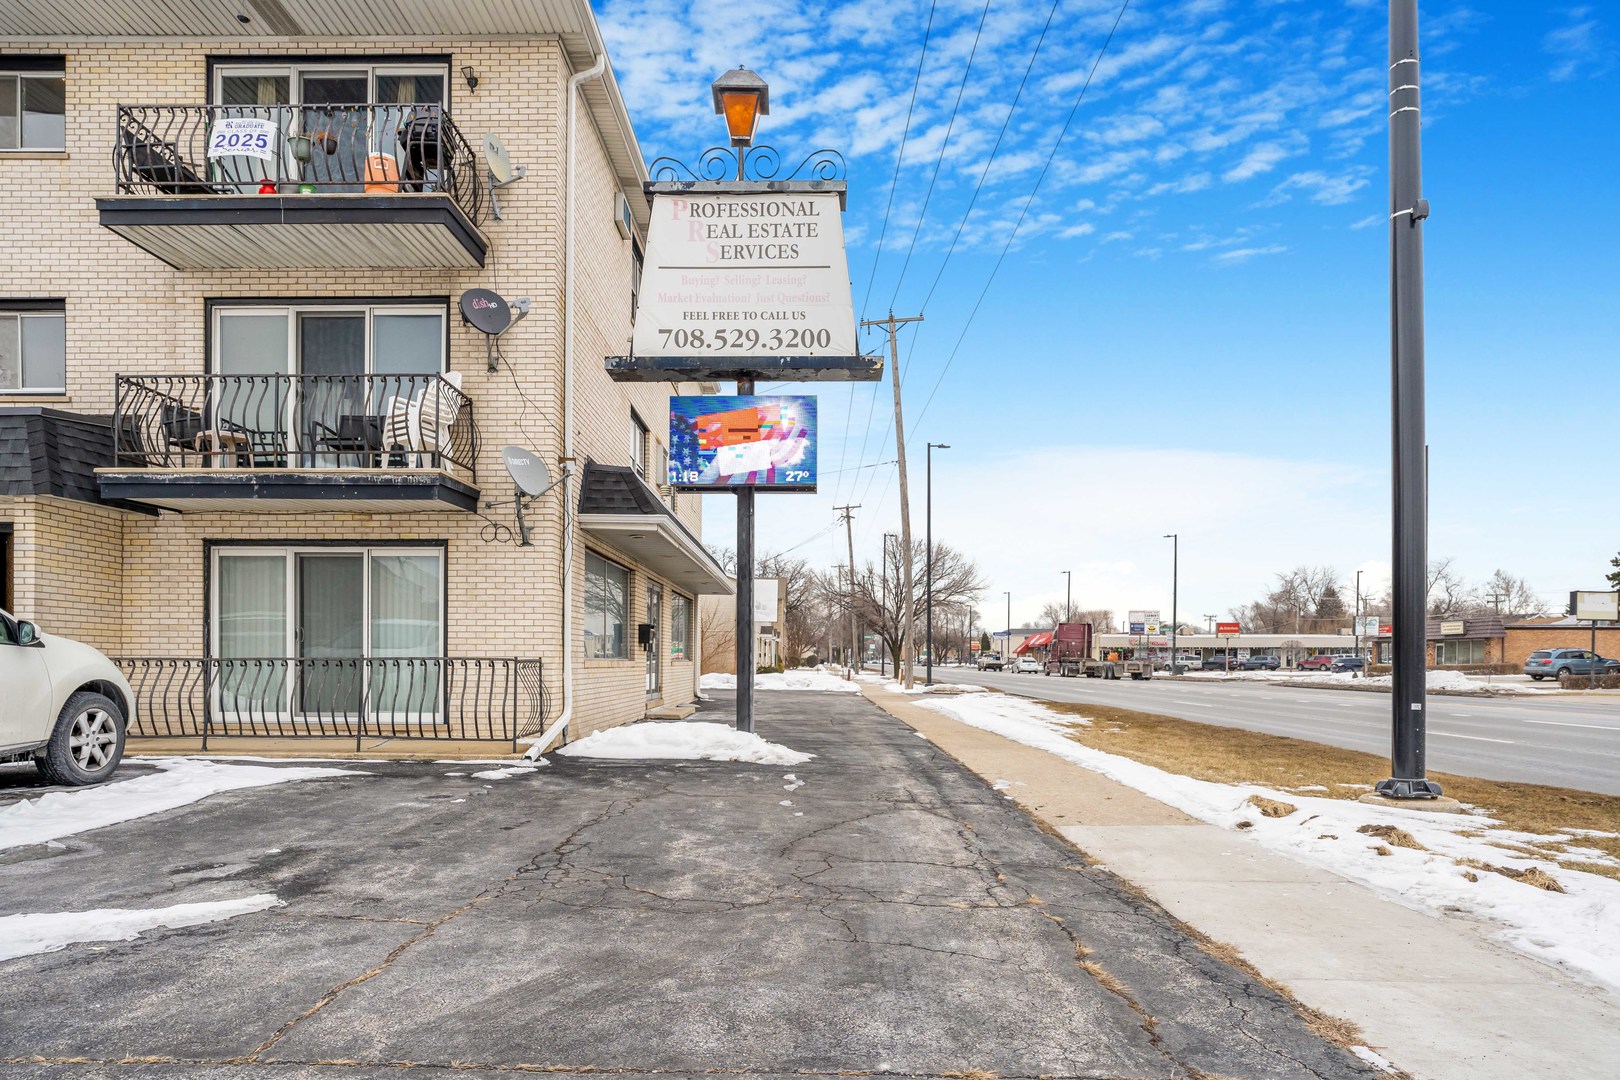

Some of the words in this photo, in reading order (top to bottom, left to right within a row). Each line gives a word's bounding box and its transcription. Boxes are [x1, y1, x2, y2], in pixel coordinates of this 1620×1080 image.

[214, 133, 269, 148] 2025
[671, 199, 820, 221] PROFESSIONAL
[688, 220, 743, 242] REAL
[748, 222, 819, 239] ESTATE
[705, 241, 800, 263] SERVICES
[681, 275, 720, 288] Buying?
[724, 274, 762, 288] Selling?
[765, 274, 807, 287] Leasing?
[472, 297, 489, 309] dish
[657, 293, 693, 304] Market
[695, 293, 752, 304] Evaluation?
[777, 292, 831, 304] Questions?
[683, 311, 710, 321] FEEL
[712, 311, 740, 321] FREE
[742, 311, 758, 321] TO
[760, 311, 789, 321] CALL
[792, 311, 806, 321] US
[657, 328, 832, 351] 708.529.3200
